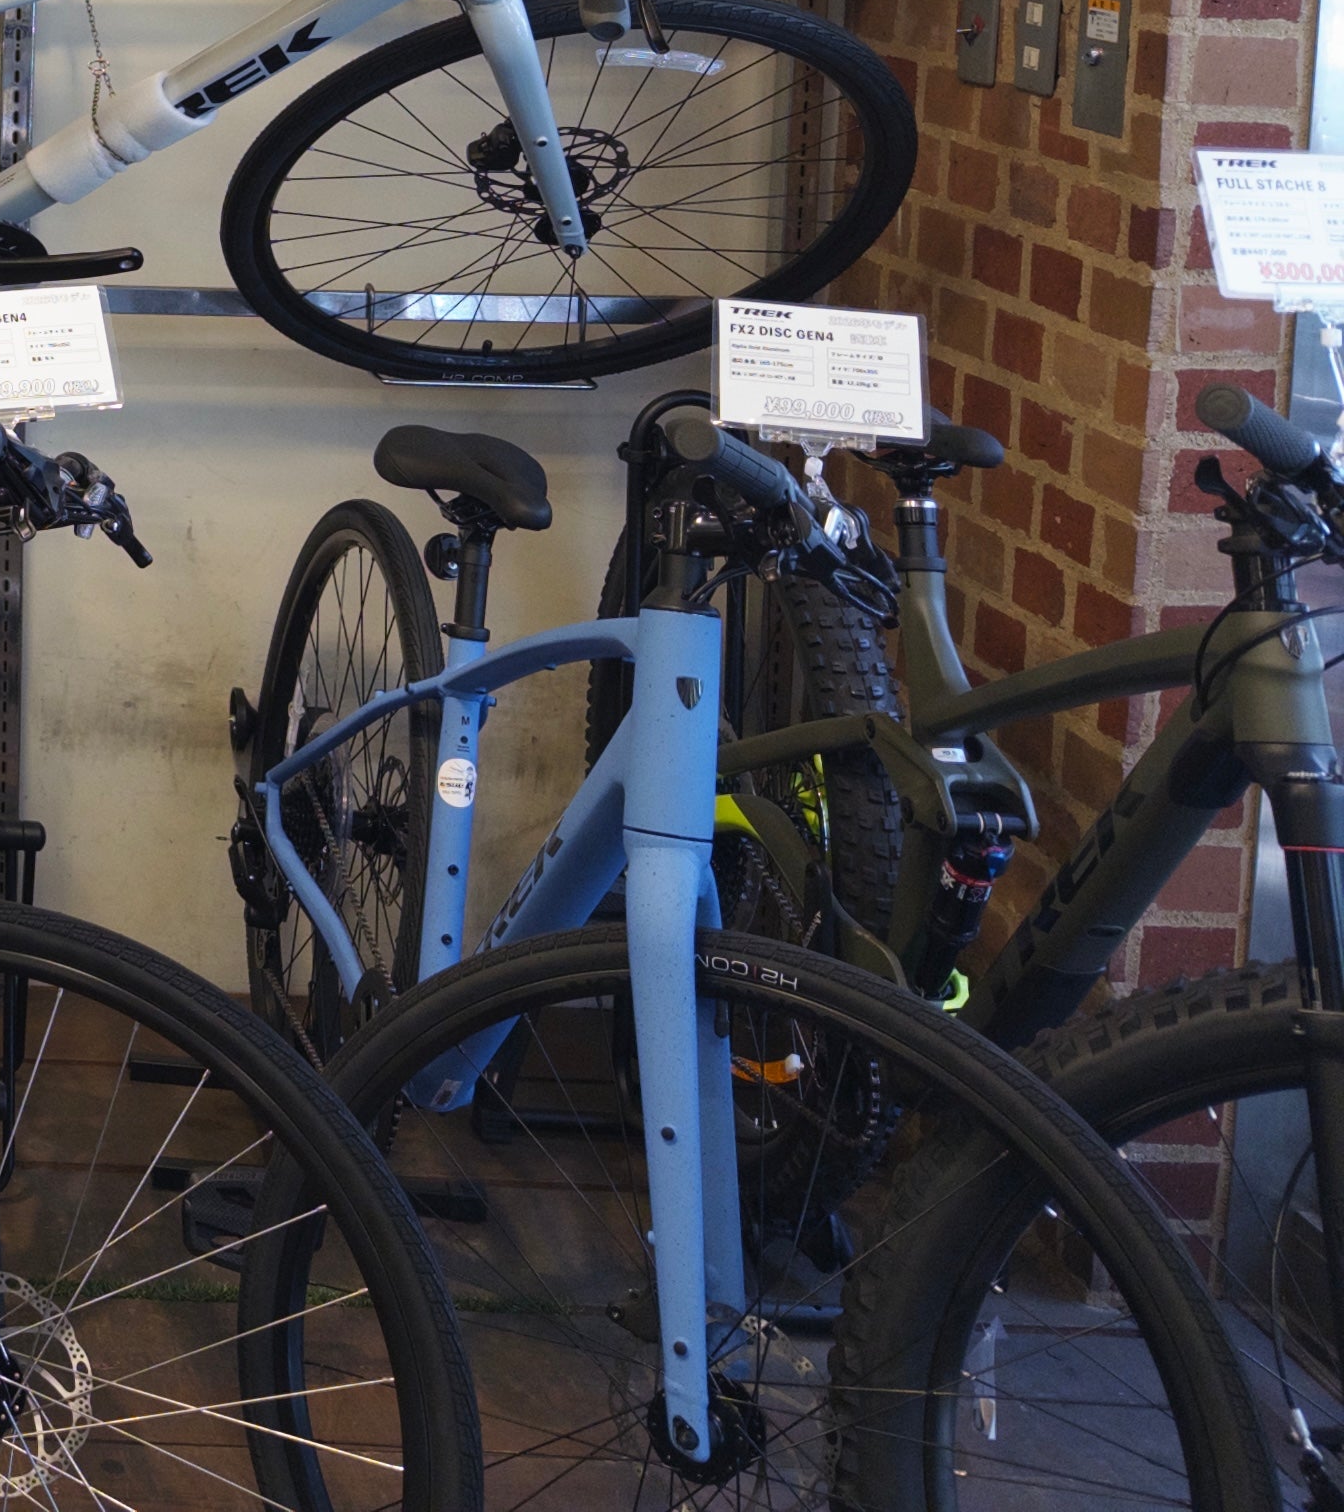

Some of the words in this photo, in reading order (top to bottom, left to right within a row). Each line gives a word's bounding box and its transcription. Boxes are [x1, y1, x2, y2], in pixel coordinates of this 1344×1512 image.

[174, 17, 332, 119] REK
[1213, 158, 1277, 169] TREK
[1216, 178, 1253, 190] FULL
[1256, 179, 1313, 192] STACHE
[730, 306, 794, 319] TREK
[730, 323, 755, 336] FX2
[759, 326, 792, 339] DISC
[797, 331, 834, 342] GEN4
[764, 396, 854, 420] ¥99,000
[461, 715, 471, 726] M
[760, 968, 798, 991] H2
